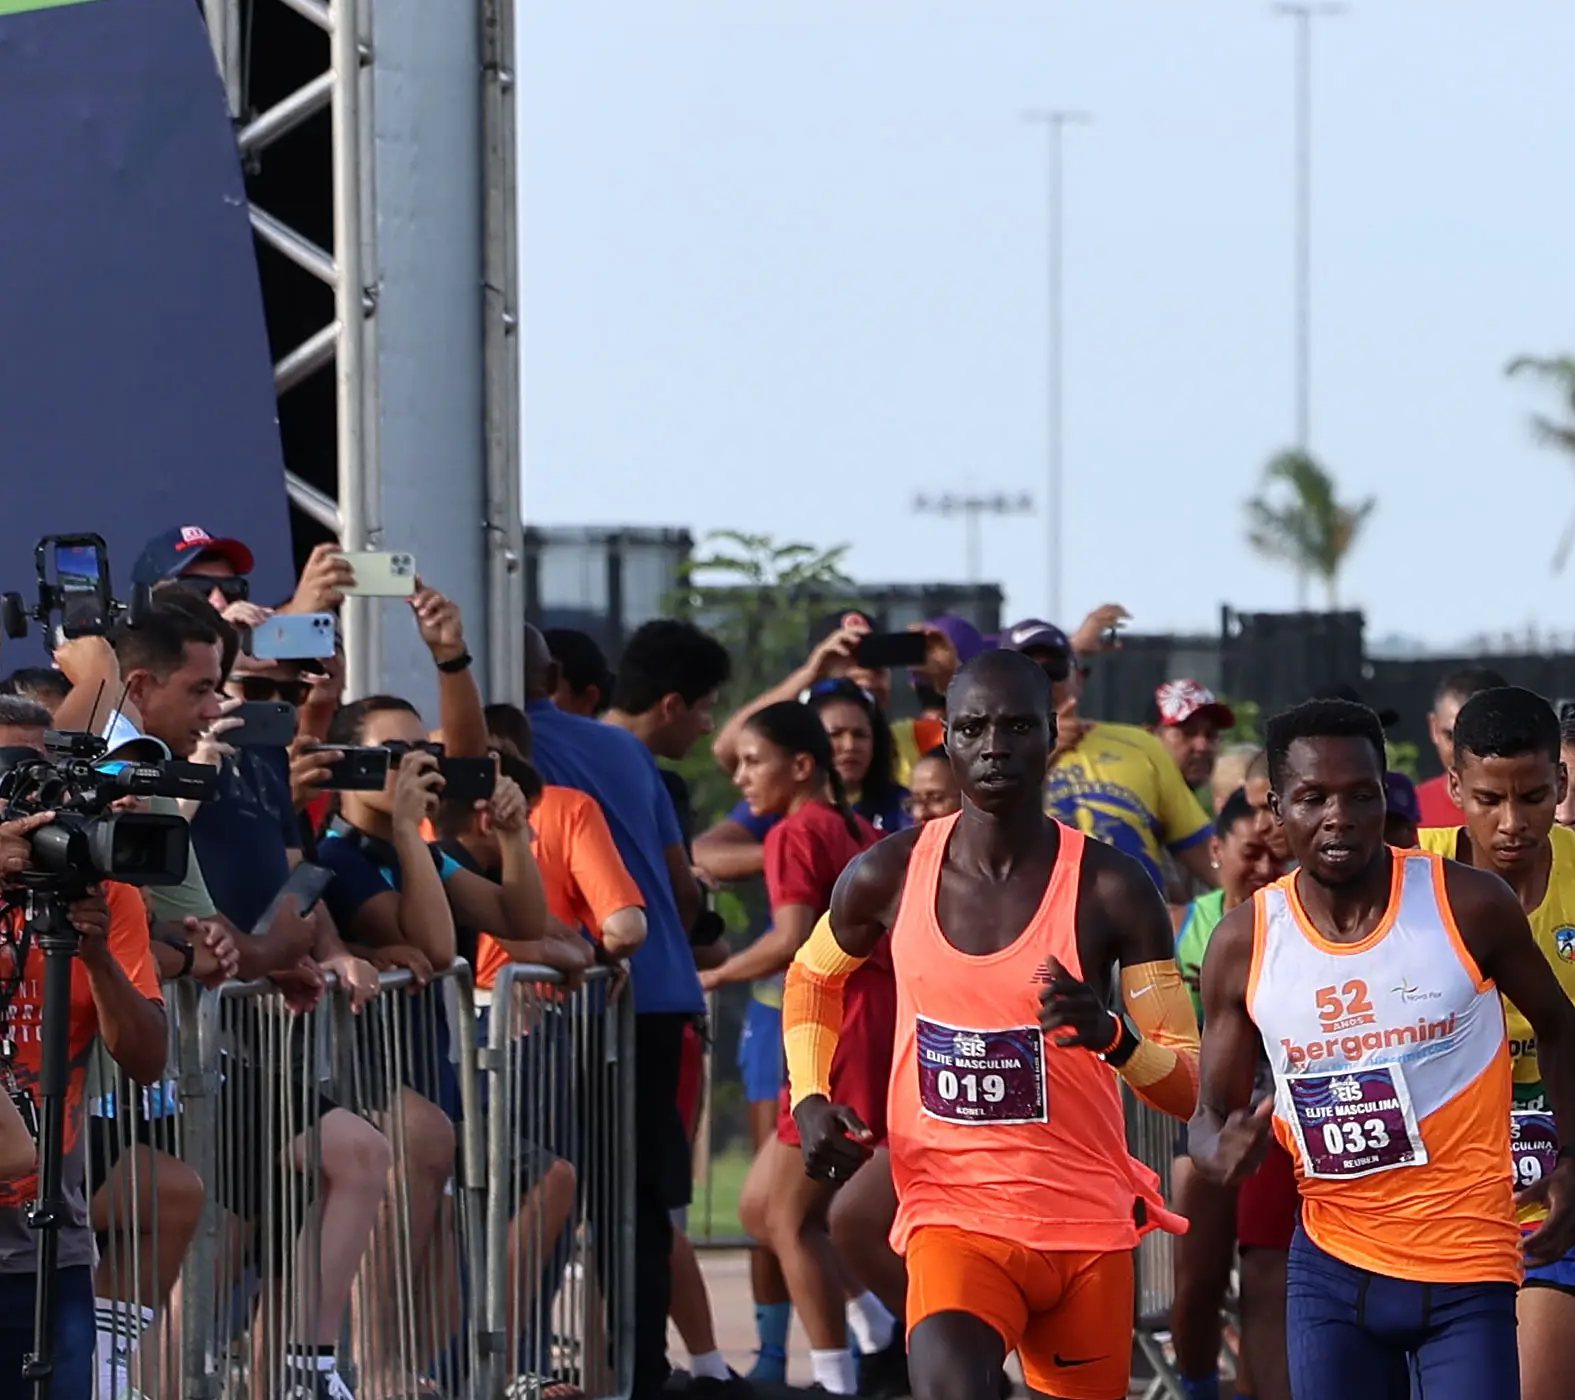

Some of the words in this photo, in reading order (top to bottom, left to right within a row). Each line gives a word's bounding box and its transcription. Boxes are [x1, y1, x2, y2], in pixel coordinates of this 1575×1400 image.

[1316, 979, 1374, 1021] 52
[1281, 1012, 1455, 1064] bergamini
[1334, 1018, 1365, 1032] ANOS
[927, 1049, 953, 1066] ELITE
[955, 1058, 1021, 1069] MASCULINA
[938, 1070, 1005, 1102] 019
[1305, 1104, 1334, 1118] ELITE
[1335, 1098, 1400, 1116] MASCULINA
[1323, 1118, 1390, 1154] 033
